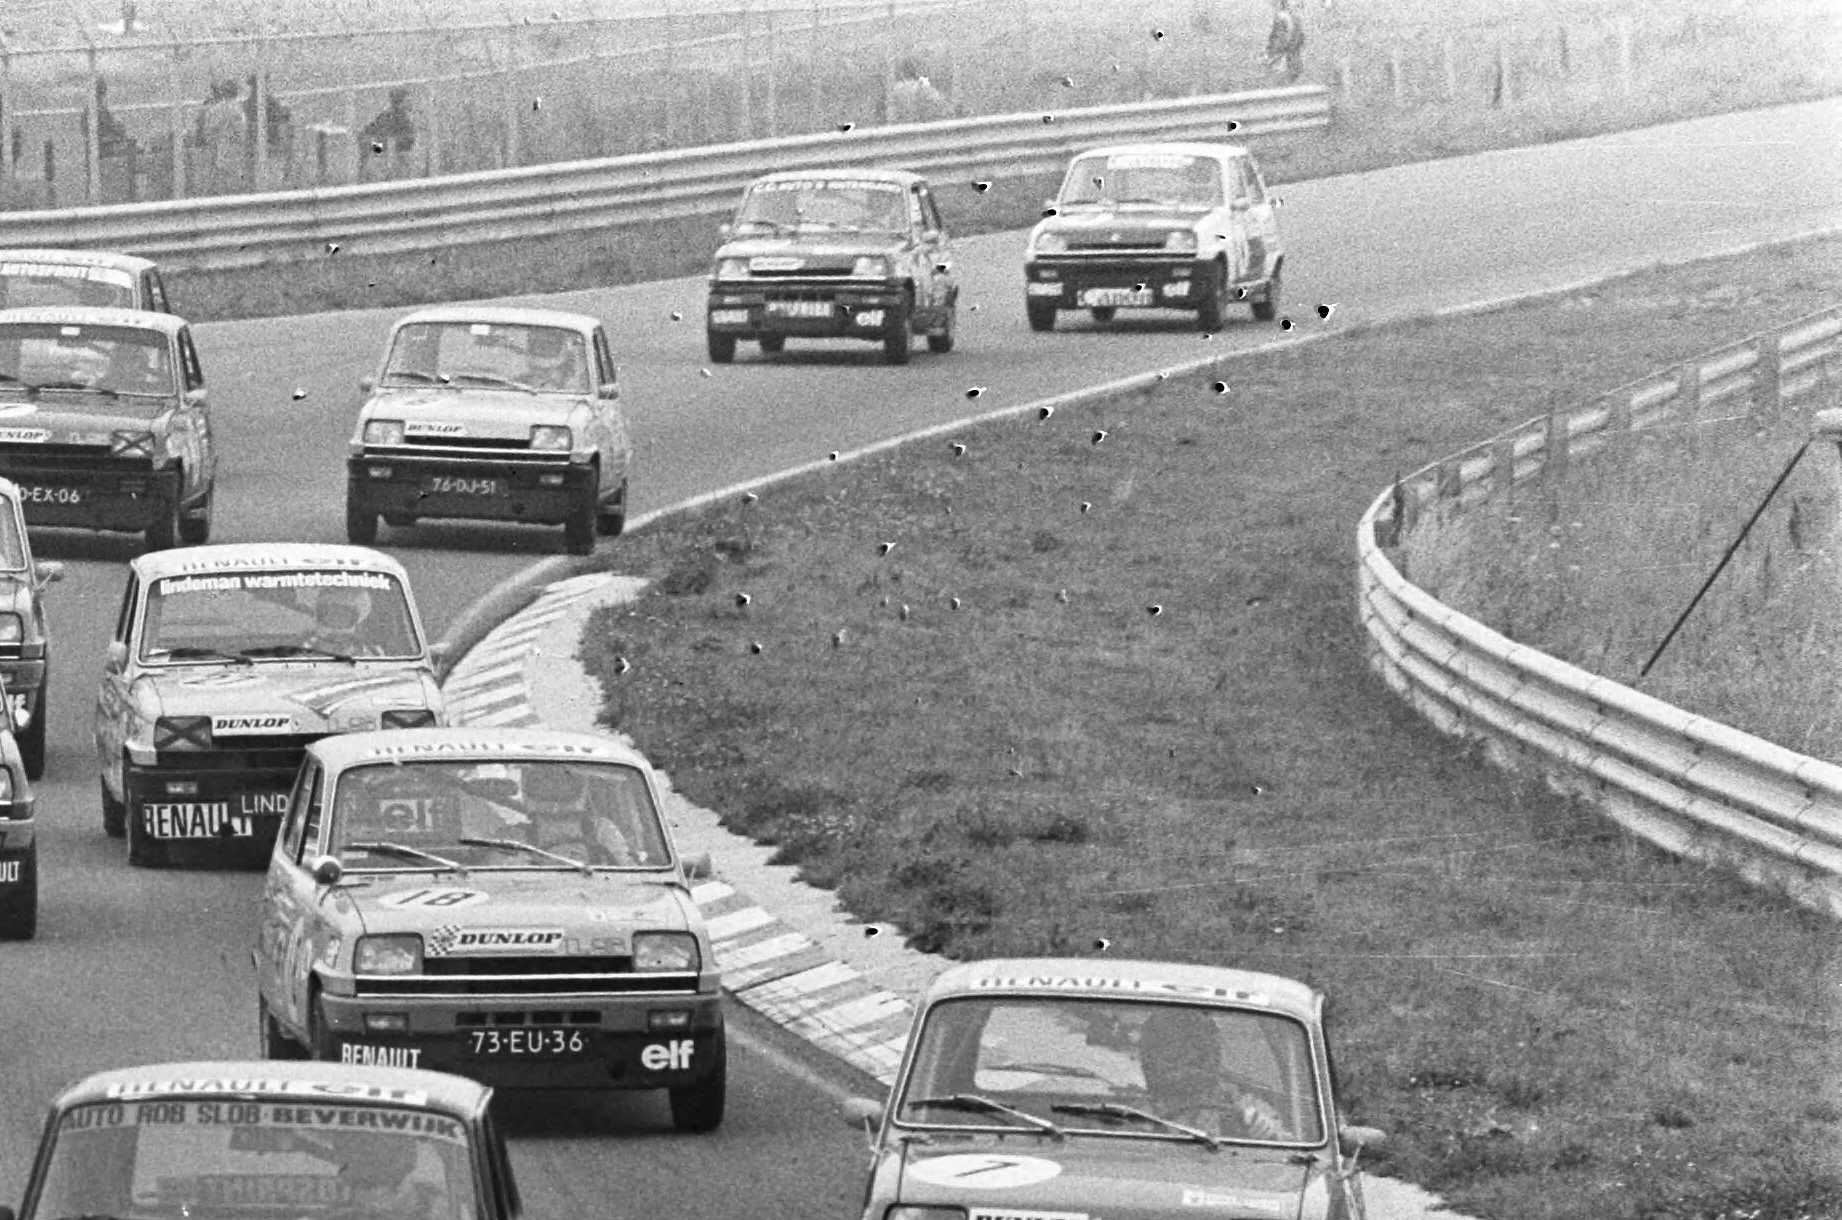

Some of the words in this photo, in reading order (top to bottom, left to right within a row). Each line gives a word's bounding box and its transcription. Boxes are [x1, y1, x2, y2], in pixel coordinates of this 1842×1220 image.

[161, 576, 241, 595] lindeman
[215, 718, 289, 729] DUNLOP
[396, 889, 477, 907] 18
[460, 932, 563, 945] DUNLOP
[472, 1030, 584, 1053] 73-EU-36
[341, 1043, 422, 1070] RENAULT
[641, 1039, 695, 1070] elf
[64, 1105, 124, 1131] AUTO
[136, 1103, 186, 1125] ROB
[955, 1159, 1022, 1178] 7
